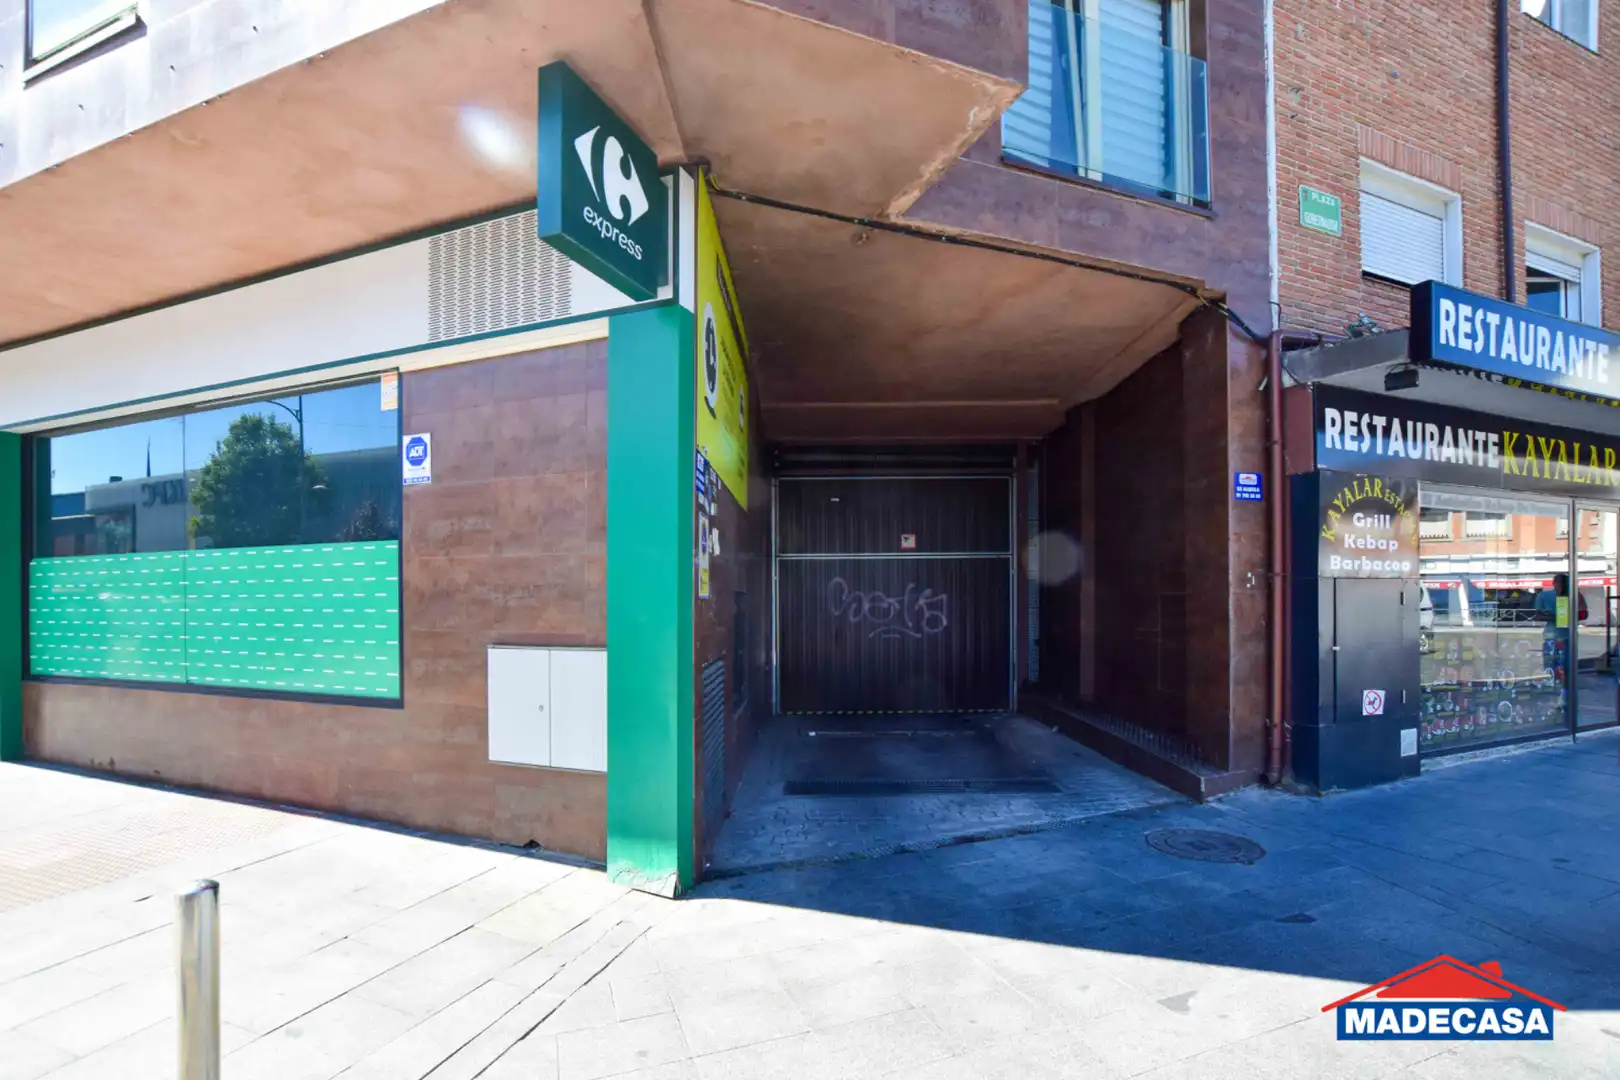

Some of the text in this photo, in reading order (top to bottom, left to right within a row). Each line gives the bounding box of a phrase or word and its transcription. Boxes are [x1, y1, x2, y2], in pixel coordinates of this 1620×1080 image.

[1311, 191, 1336, 206] PLAZA
[583, 205, 643, 262] express
[1439, 297, 1610, 383] RESTAURANTE
[409, 445, 425, 458] ADT
[1324, 407, 1619, 488] RESTAURANTE KAYALAR
[1321, 477, 1383, 543] KAYALAR
[1352, 512, 1391, 529] Grill
[1344, 533, 1399, 552] Kebap
[1329, 554, 1412, 572] Barbacoa
